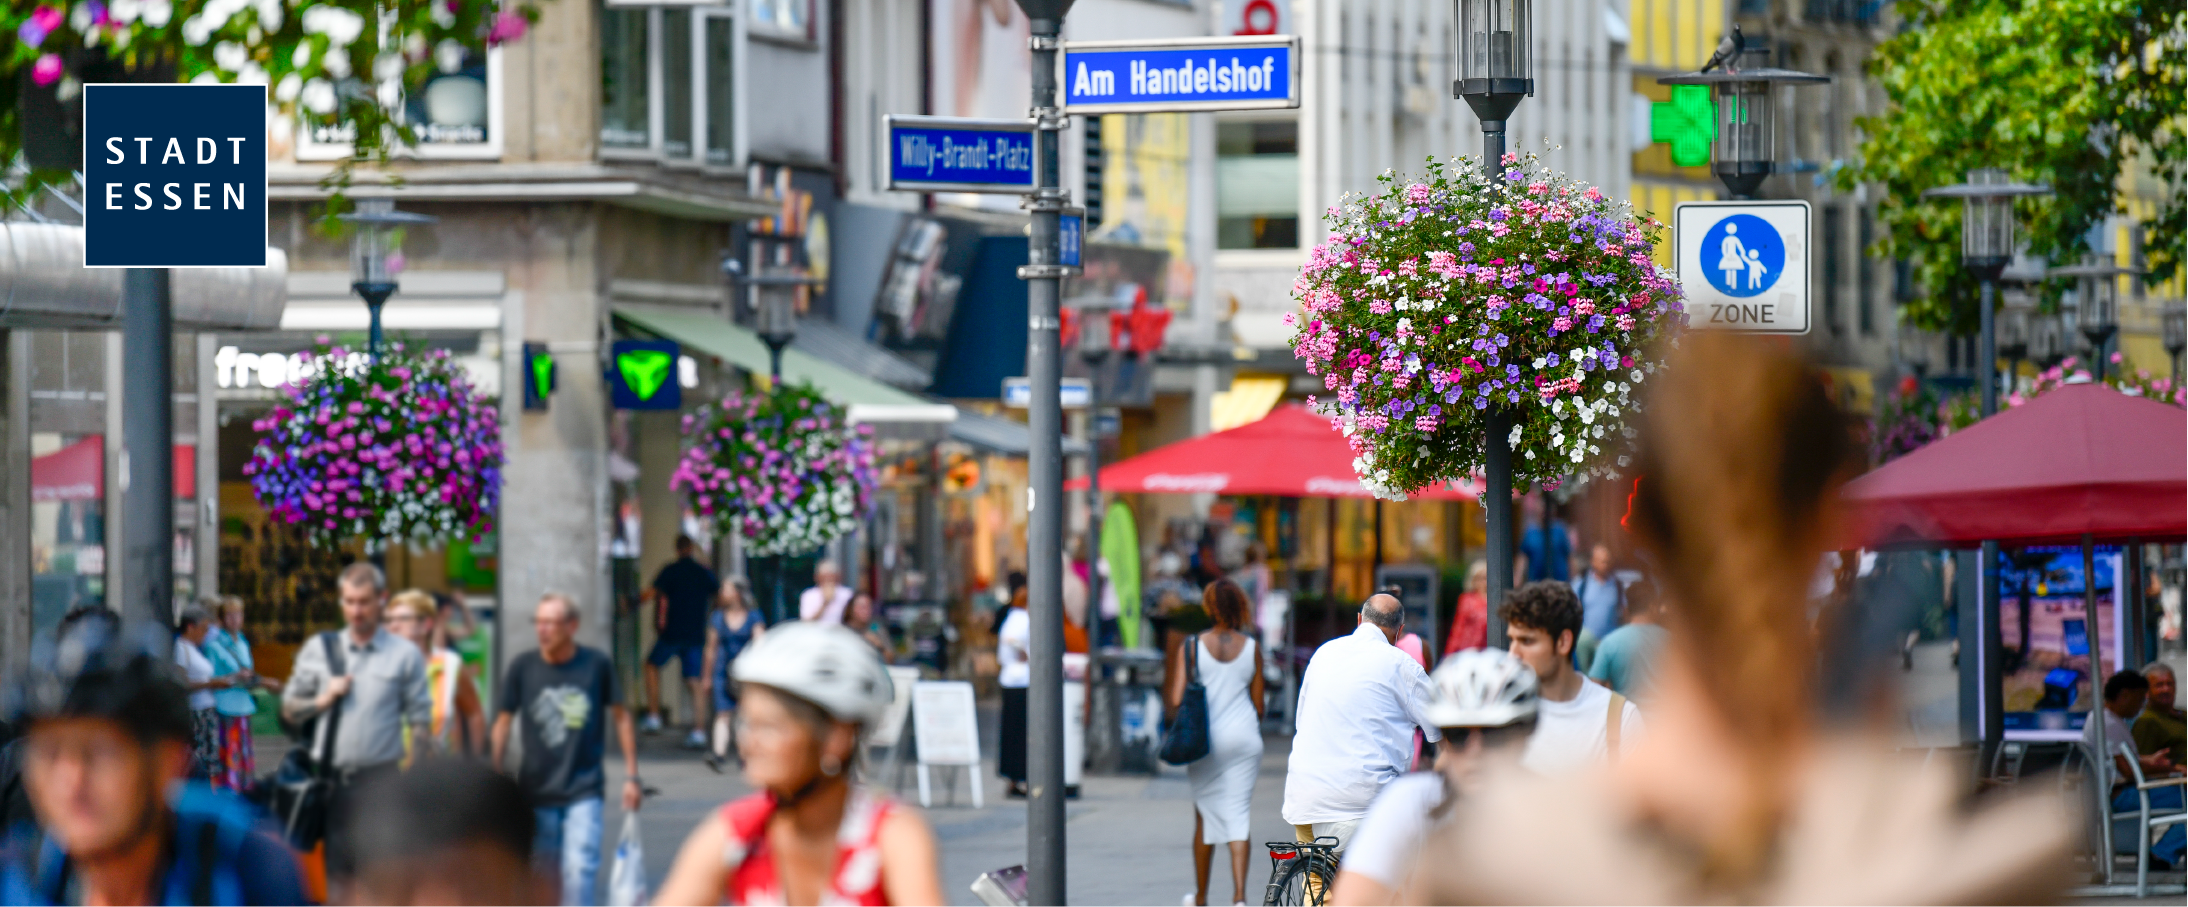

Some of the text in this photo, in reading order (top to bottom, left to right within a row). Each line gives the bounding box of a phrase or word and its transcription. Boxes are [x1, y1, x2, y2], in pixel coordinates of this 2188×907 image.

[1073, 56, 1275, 96] Am Handelshof
[900, 134, 1030, 177] Willy-Brandt-Platz
[1710, 303, 1775, 324] ZONE
